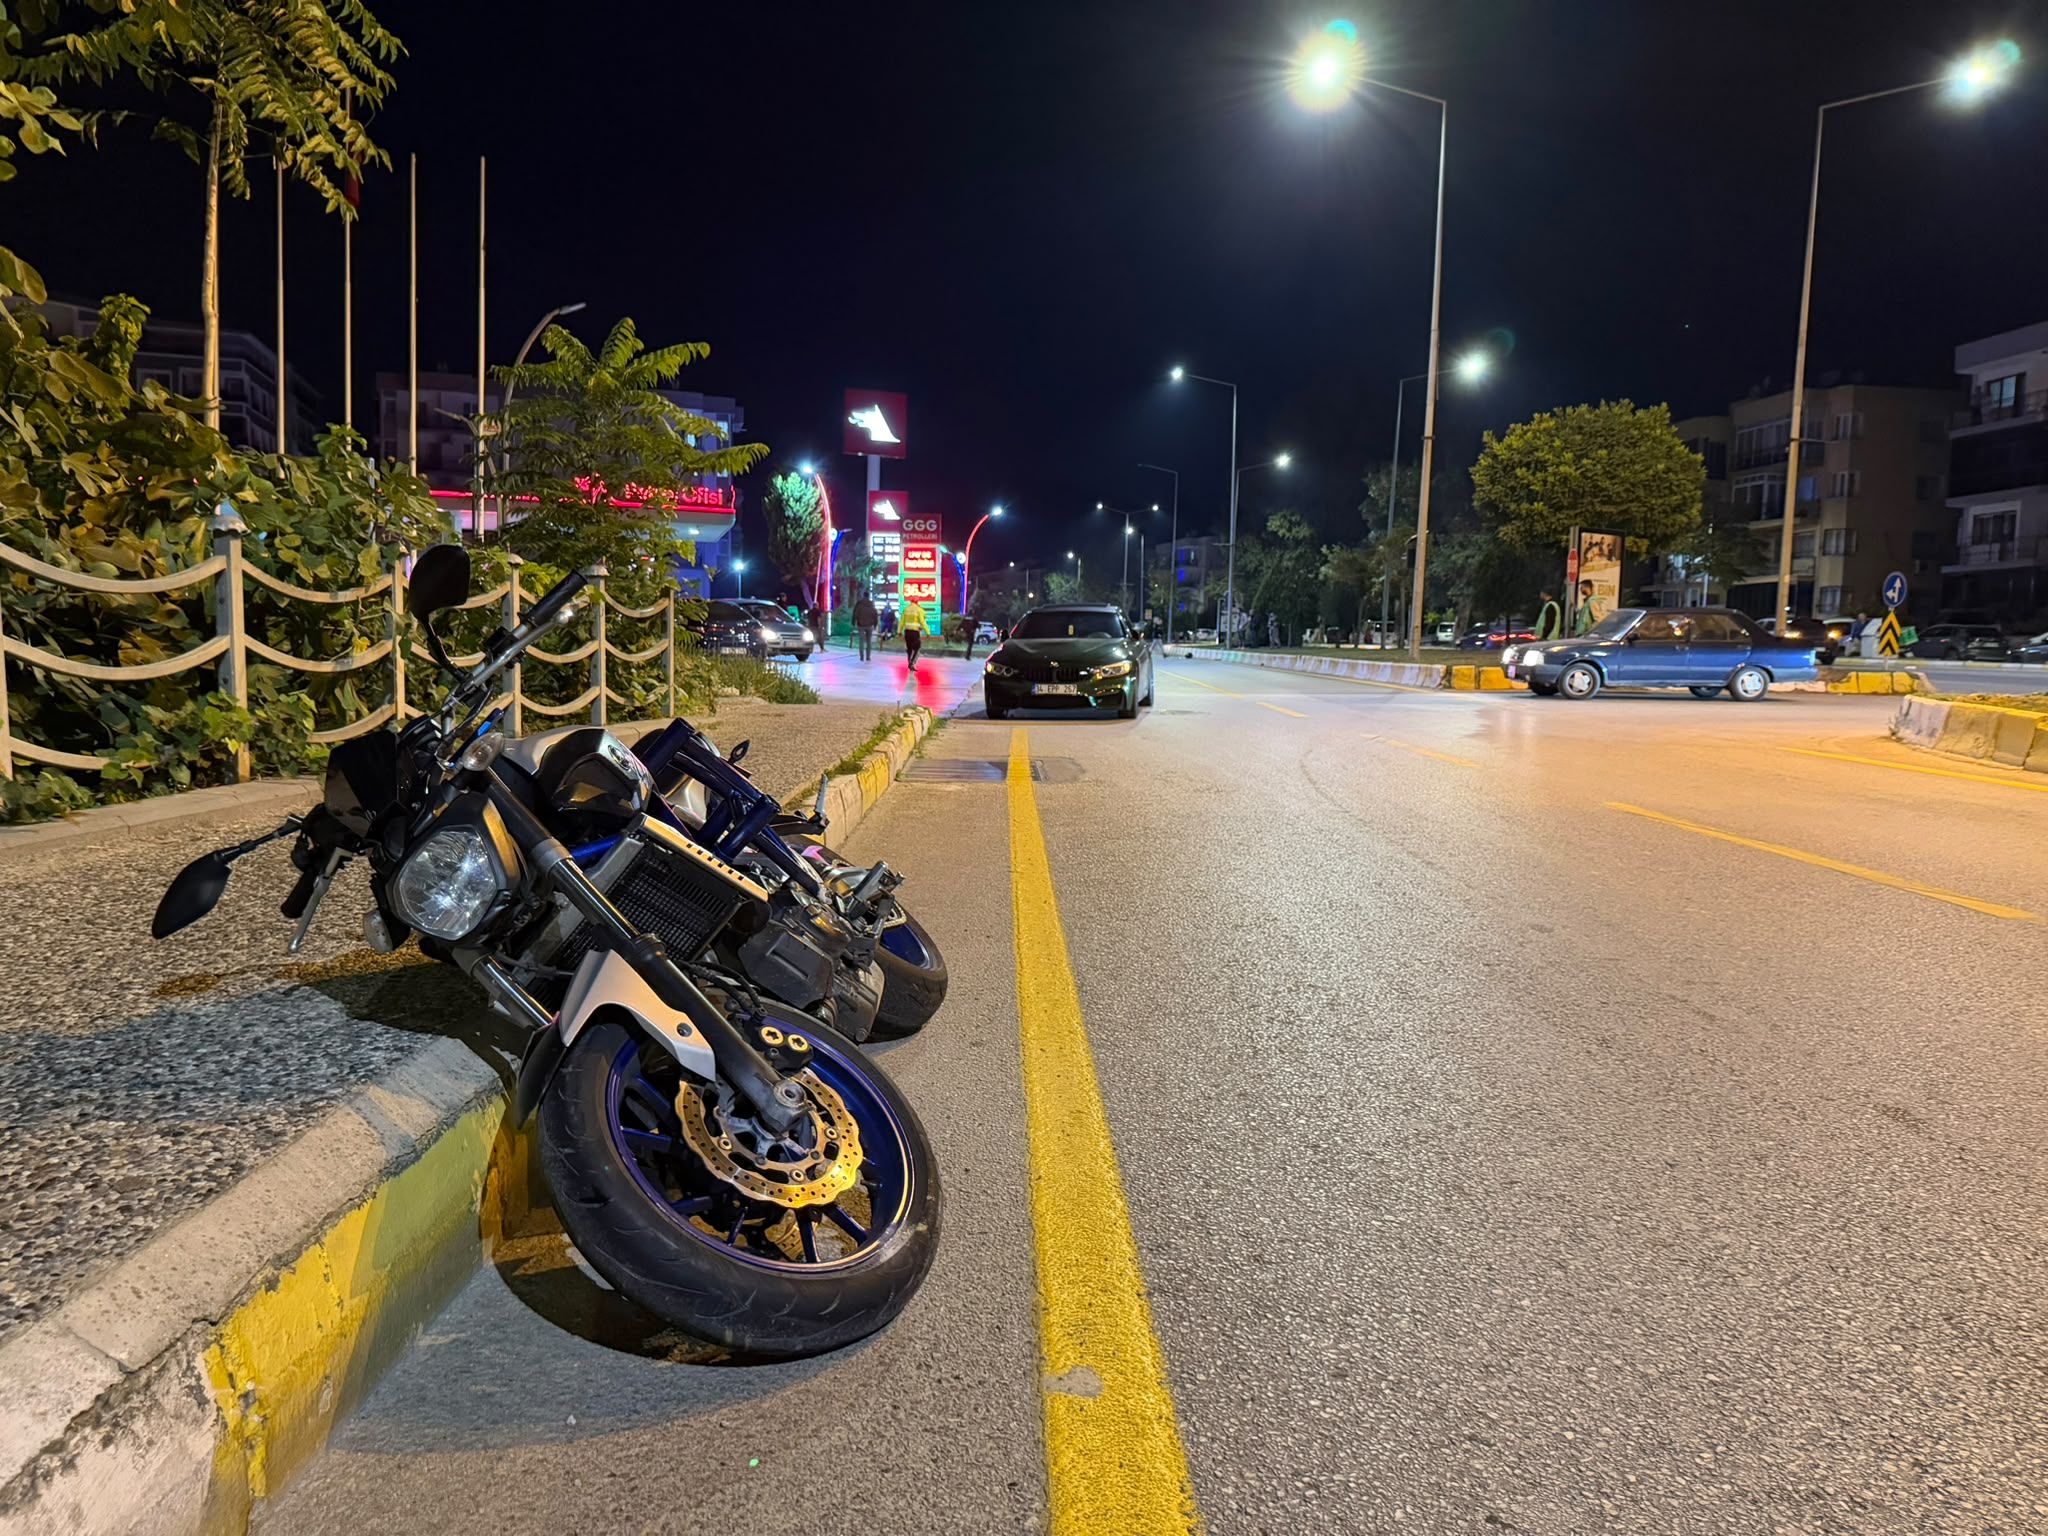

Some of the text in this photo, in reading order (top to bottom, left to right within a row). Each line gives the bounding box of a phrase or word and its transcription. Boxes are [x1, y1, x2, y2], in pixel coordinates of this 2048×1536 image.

[681, 486, 723, 505] Ofisi
[902, 519, 937, 531] GGG
[904, 583, 936, 597] 36.54
